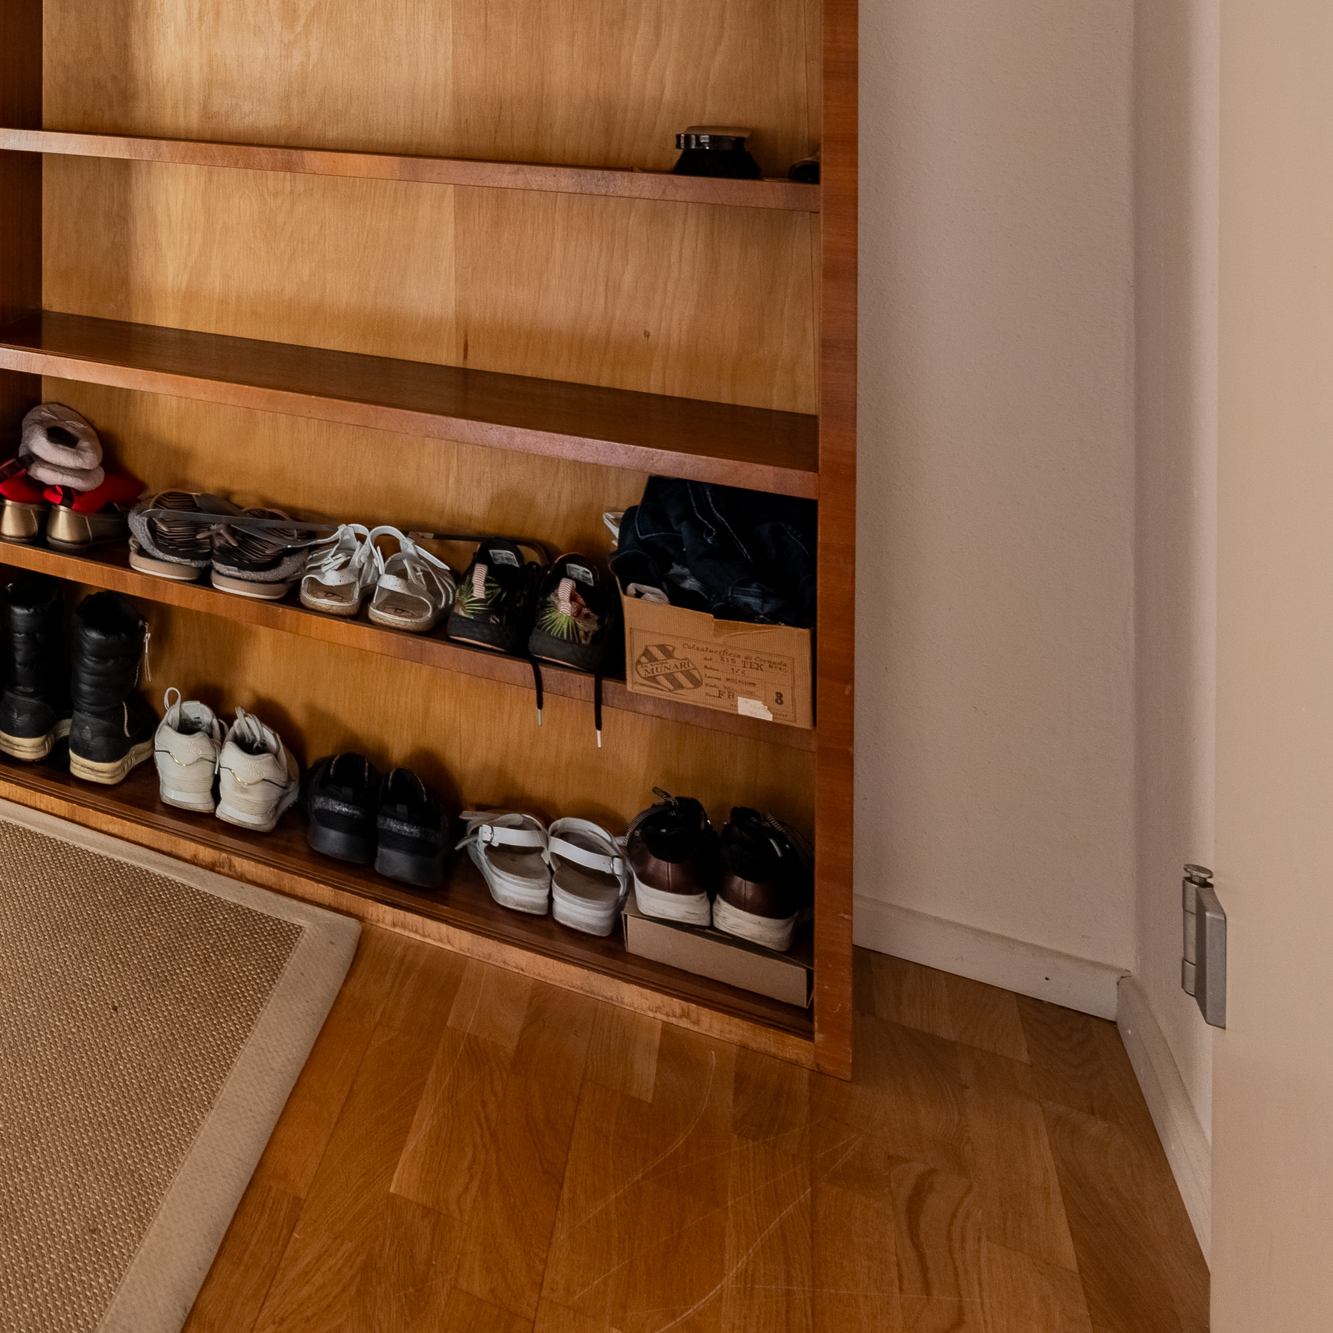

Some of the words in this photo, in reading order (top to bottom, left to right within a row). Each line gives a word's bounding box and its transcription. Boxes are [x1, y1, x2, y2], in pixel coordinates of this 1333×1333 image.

[682, 643, 740, 658] Calzaturificio
[644, 661, 690, 675] MUNARI
[742, 660, 764, 671] TEK
[718, 690, 735, 699] FR
[775, 692, 784, 705] 8
